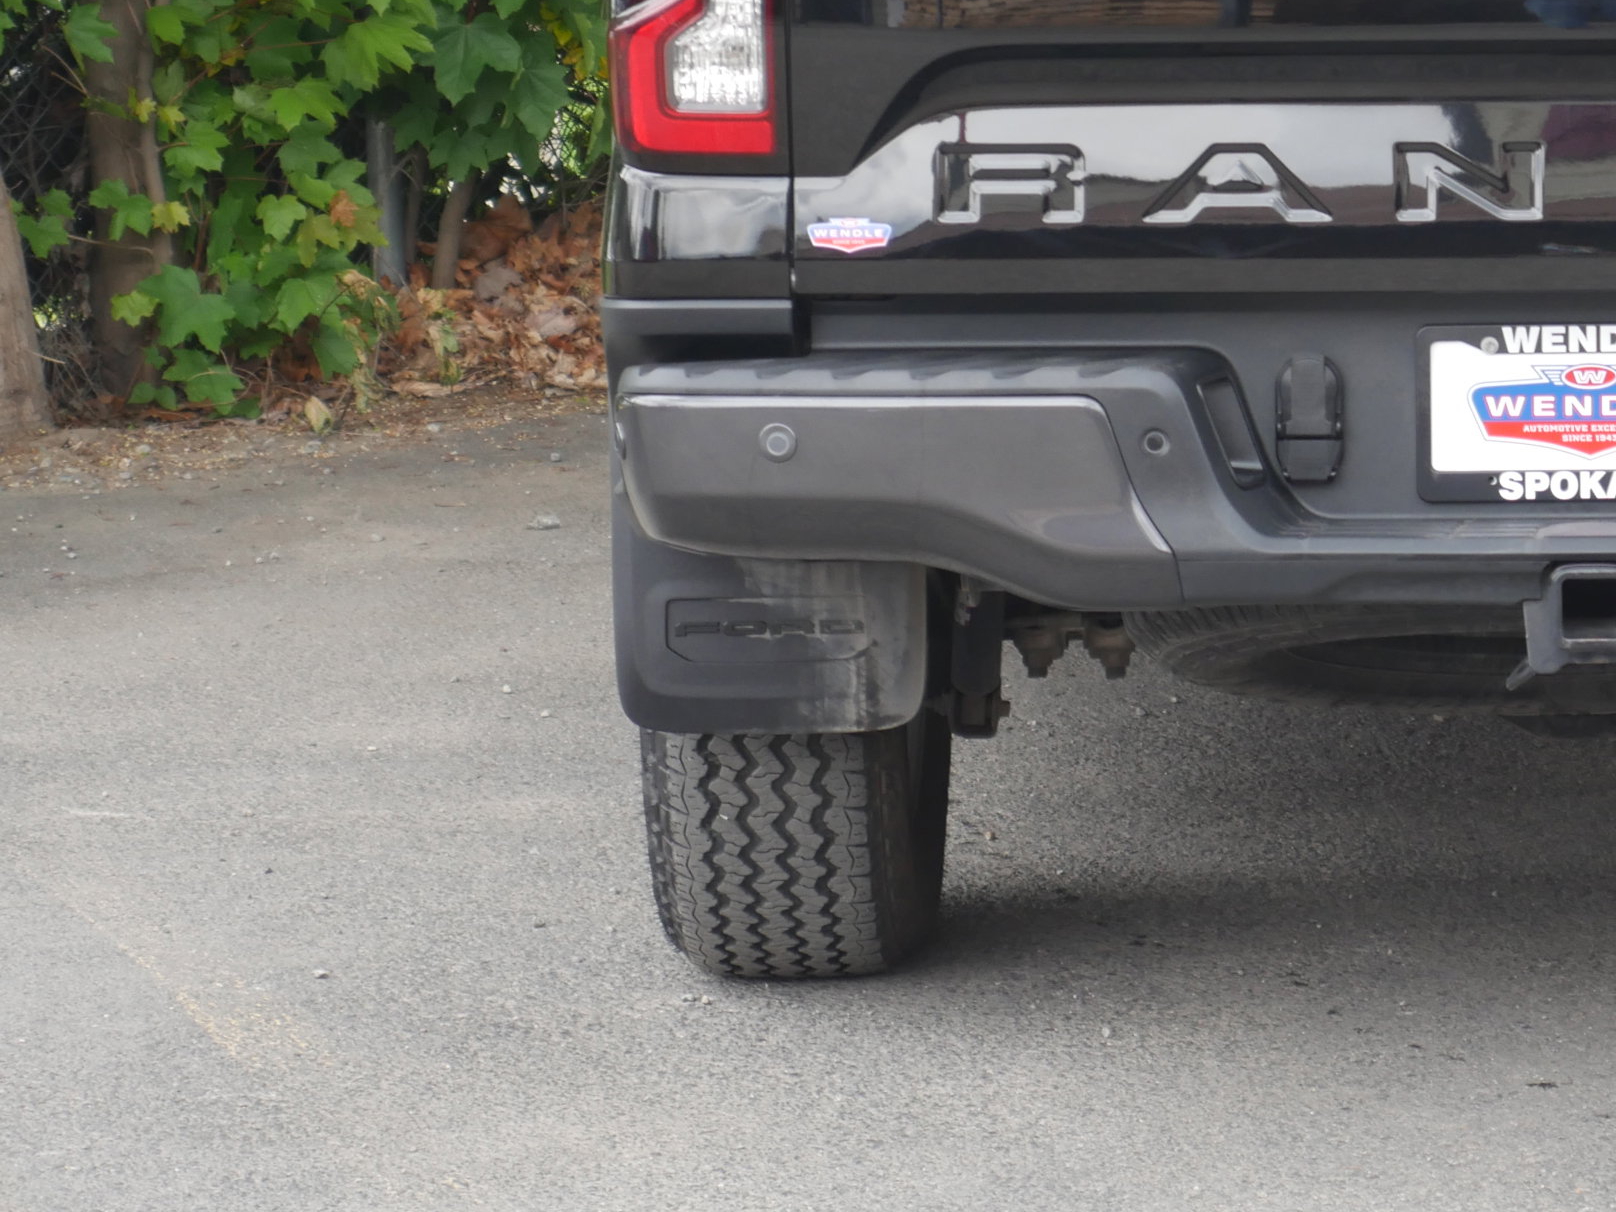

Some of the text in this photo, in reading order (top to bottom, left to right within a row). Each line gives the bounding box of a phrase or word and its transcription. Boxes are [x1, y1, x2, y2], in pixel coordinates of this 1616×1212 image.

[813, 228, 884, 238] WENDLE
[1572, 369, 1607, 385] W
[1522, 424, 1589, 433] AUTOMOTIVE
[1561, 434, 1593, 443] SINCE
[674, 620, 865, 637] FORD
